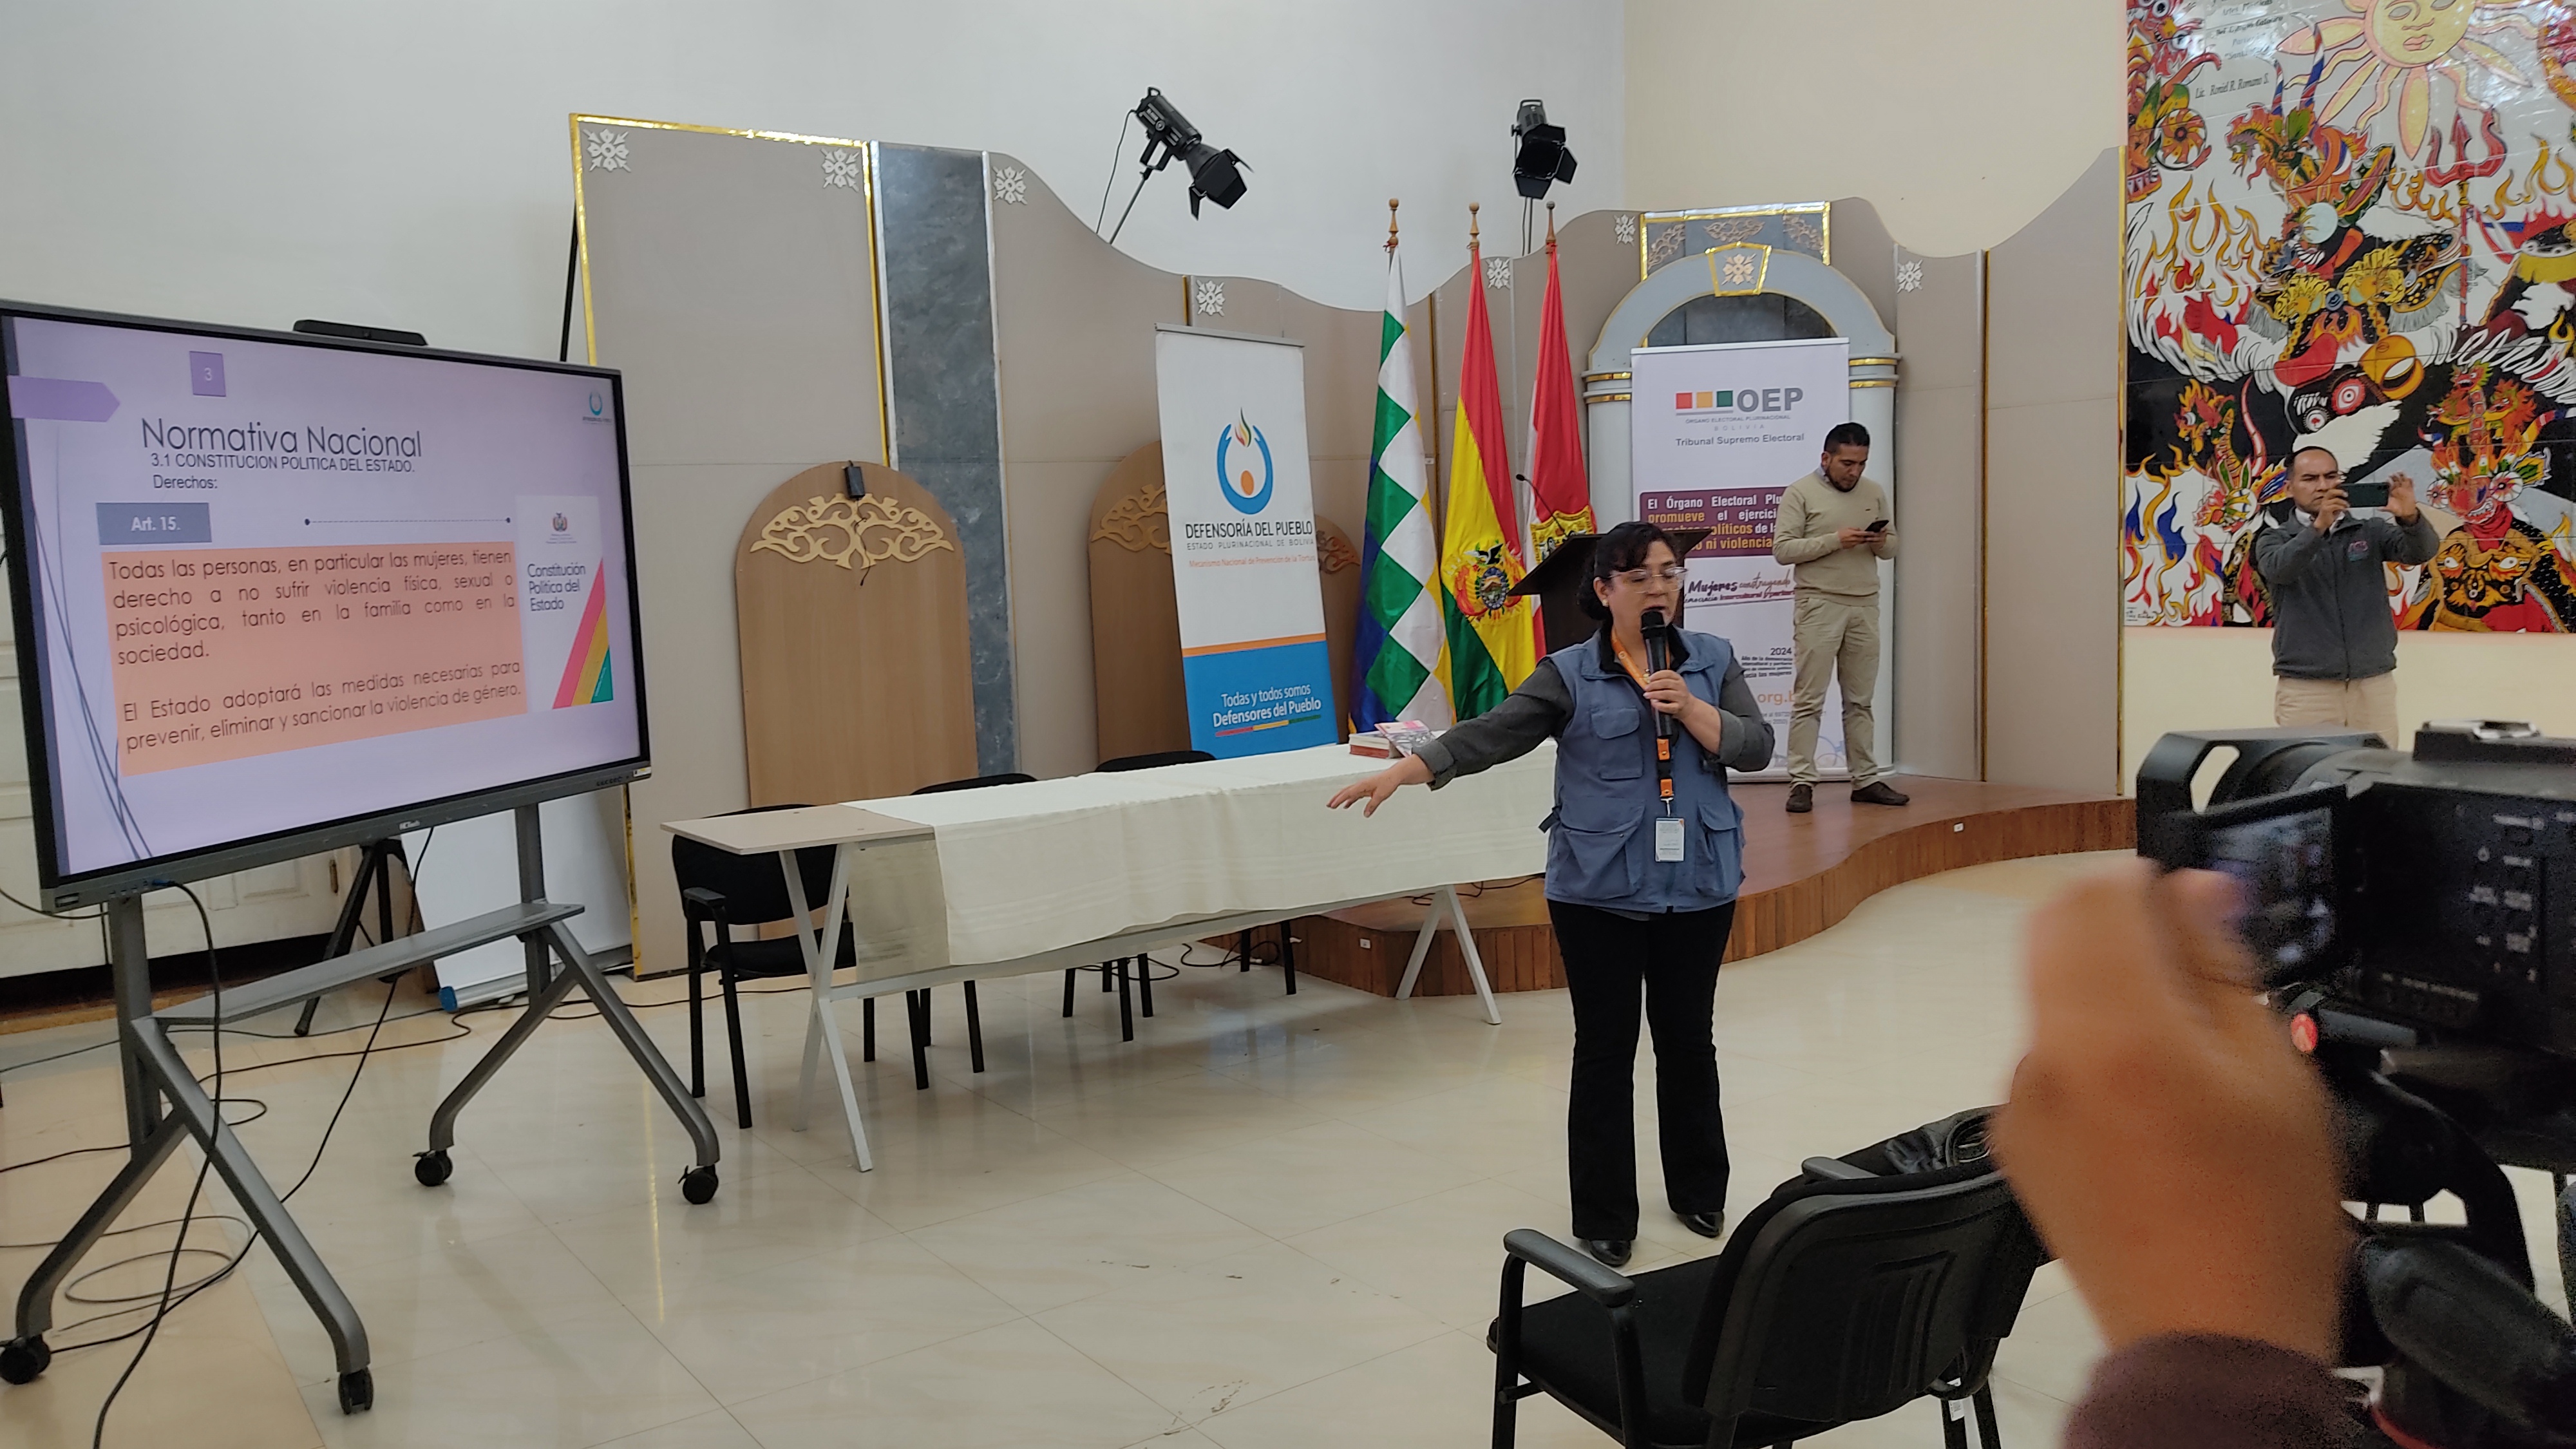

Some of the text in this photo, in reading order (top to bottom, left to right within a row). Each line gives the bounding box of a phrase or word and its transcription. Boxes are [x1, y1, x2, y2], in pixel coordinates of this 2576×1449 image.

[204, 367, 213, 381] 3
[1737, 388, 1804, 413] OEP
[142, 418, 422, 457] Normativa Nacional
[1675, 433, 1804, 446] Tribunal Supremo Electoral
[151, 453, 415, 473] 3.1 CONSTITUCION POLITICA DEL ESTADO.
[153, 474, 218, 489] Derechos:
[1647, 498, 1658, 509] El
[1666, 495, 1703, 511] Órgano
[1710, 494, 1757, 507] Electoral
[131, 516, 181, 531] Art. 15.
[1648, 507, 1777, 524] promueve el ejercici
[1186, 518, 1313, 539] DEFENSORÍA DEL PUEBLO
[1707, 522, 1753, 536] olíticos
[1755, 523, 1767, 534] de
[1187, 542, 1214, 551] ESTADO
[1218, 540, 1273, 549] PLURINACIONAL
[1706, 540, 1717, 551] ni
[1719, 536, 1772, 549] violencia
[109, 549, 511, 580] Todas las personas, en particular las mujeres, tienen
[527, 562, 586, 578] Constitución
[113, 572, 513, 609] derecho a no sufrir violencia física, sexual o
[529, 578, 581, 594] Política del
[1688, 580, 1738, 596] Mujeres
[530, 596, 565, 612] Estado
[116, 593, 515, 641] psicológica, tanto en la familia como en la
[118, 640, 210, 665] sociedad.
[1770, 647, 1792, 656] 2024
[124, 661, 520, 722] El Estado adoptará las medidas necesarias para
[1221, 684, 1311, 708] Todas y todos somos
[126, 684, 522, 754] prevenir, eliminar y sancionar la violencia de género.
[1212, 697, 1321, 728] Defensores del Pueblo
